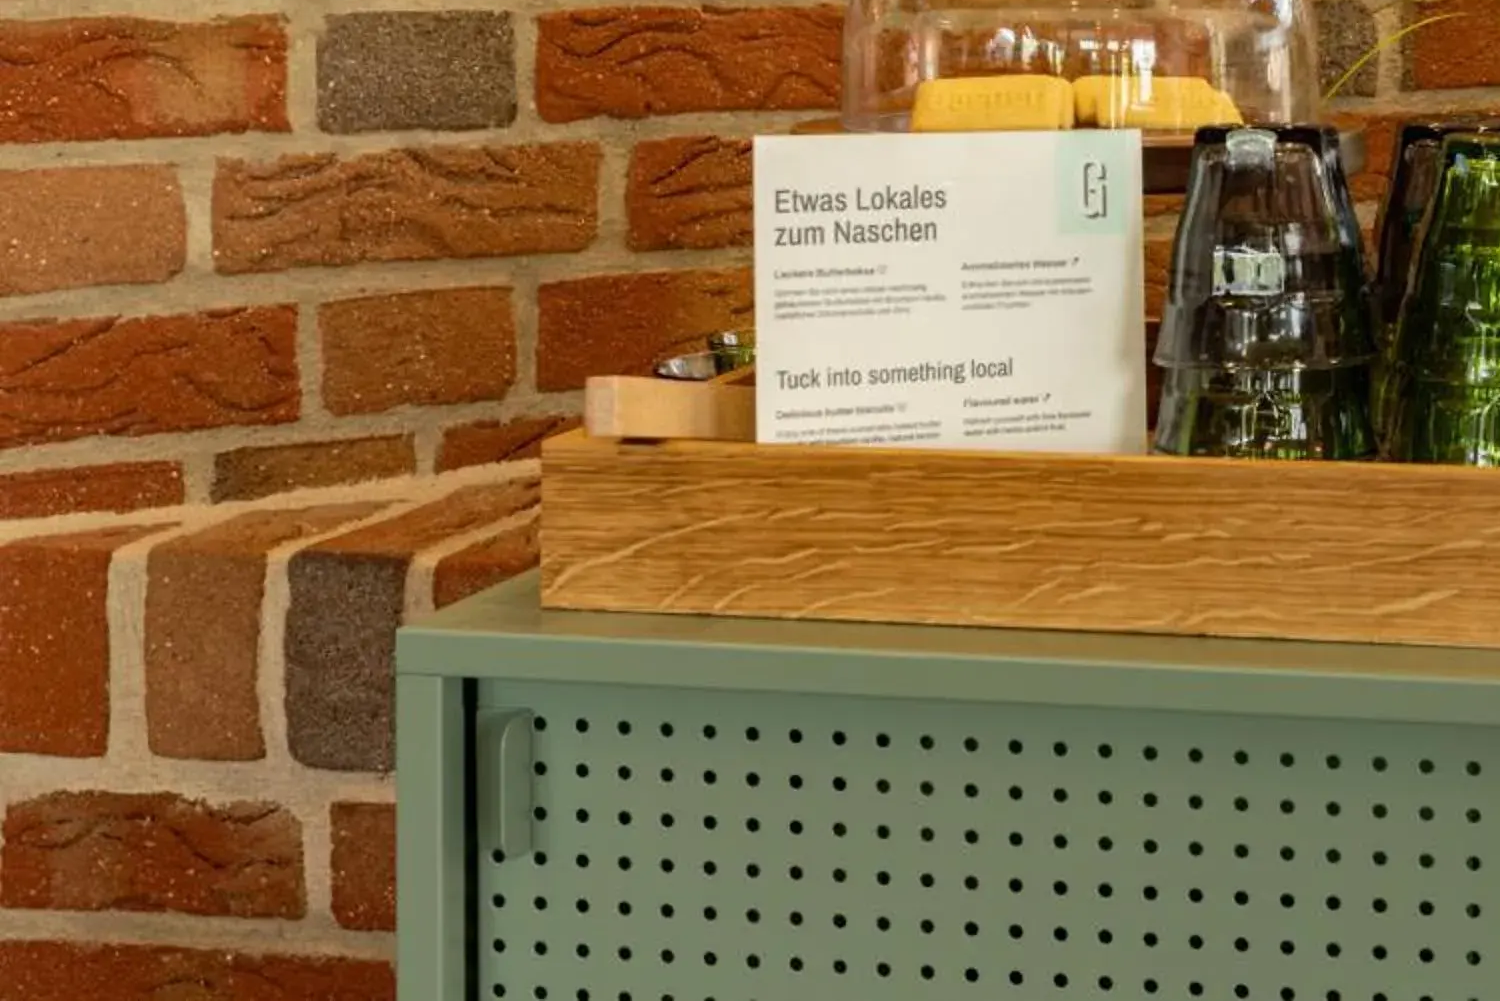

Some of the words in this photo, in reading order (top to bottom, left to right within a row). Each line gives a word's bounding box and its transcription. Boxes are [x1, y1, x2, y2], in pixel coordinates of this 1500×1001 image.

[775, 189, 848, 214] Etwas
[856, 185, 947, 211] Lokales
[774, 226, 825, 247] zum
[833, 217, 937, 244] Naschen
[777, 368, 821, 390] Tuck
[827, 367, 863, 387] into
[868, 362, 967, 385] something
[970, 357, 1013, 379] local
